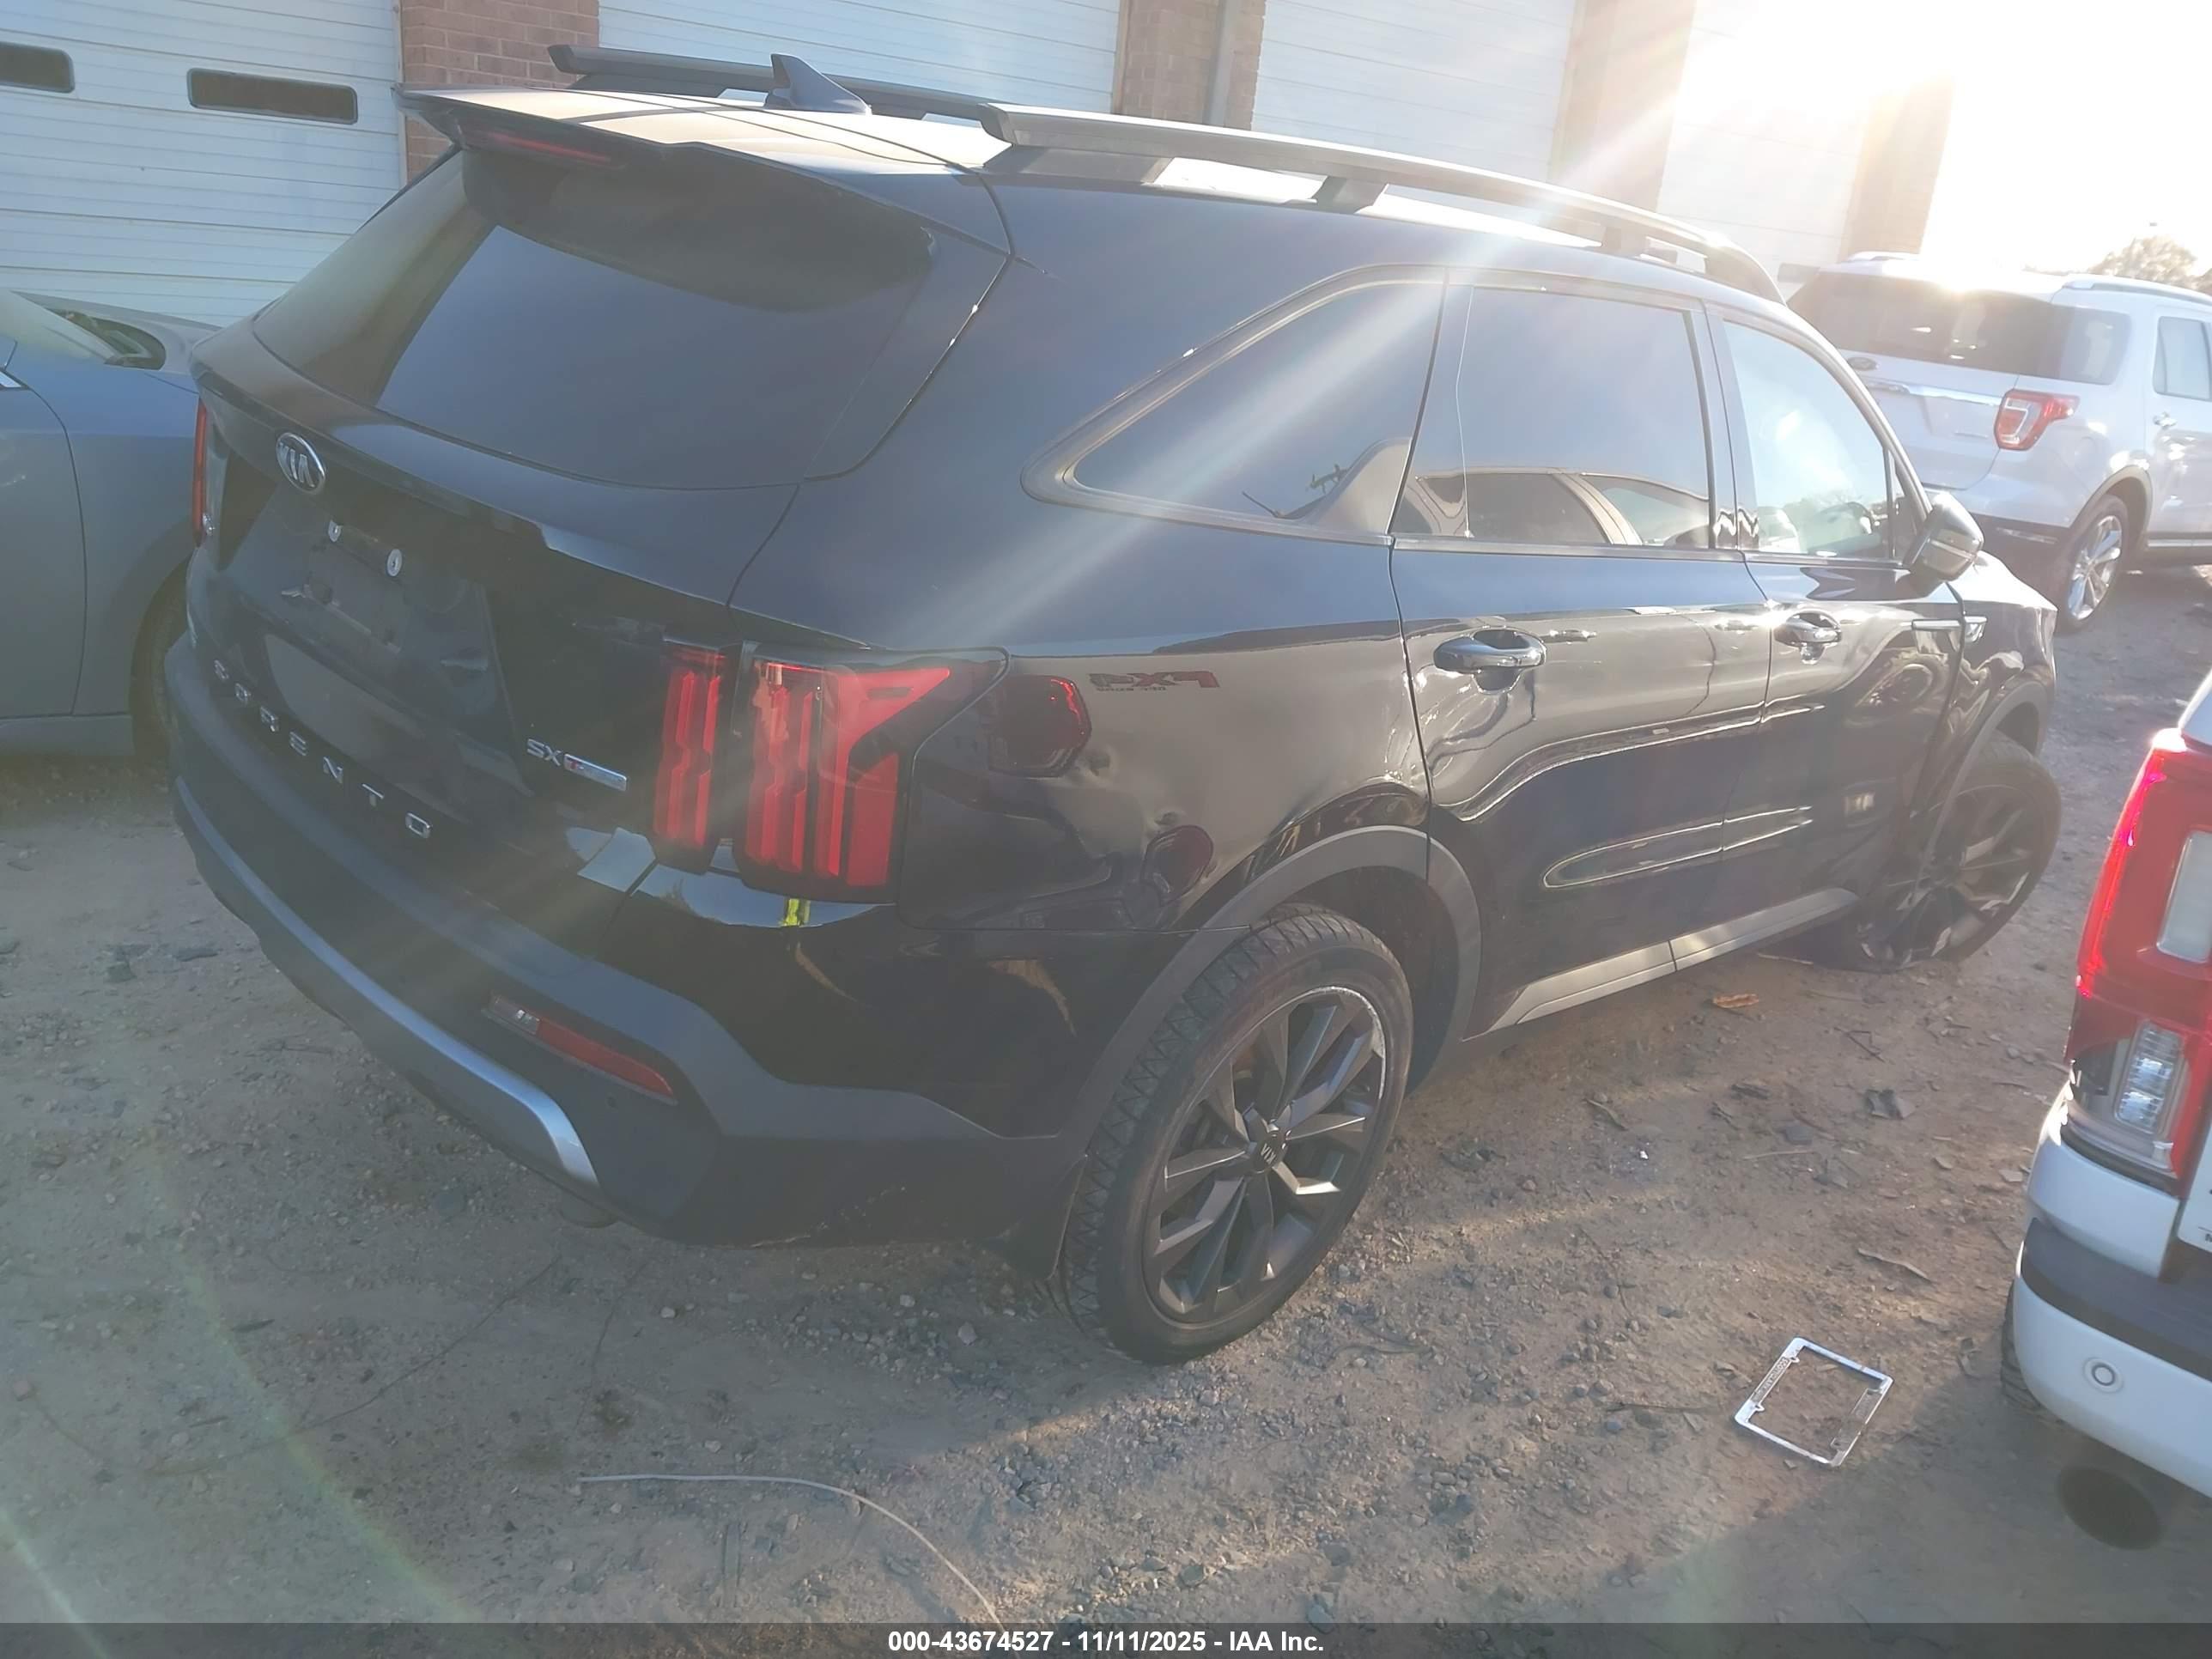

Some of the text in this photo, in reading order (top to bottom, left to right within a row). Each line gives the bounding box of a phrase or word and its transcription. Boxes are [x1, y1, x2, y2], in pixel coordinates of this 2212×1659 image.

[277, 440, 318, 489] KIA
[213, 659, 434, 839] SORENTO
[526, 738, 562, 767] SX
[1260, 1142, 1278, 1165] KIA
